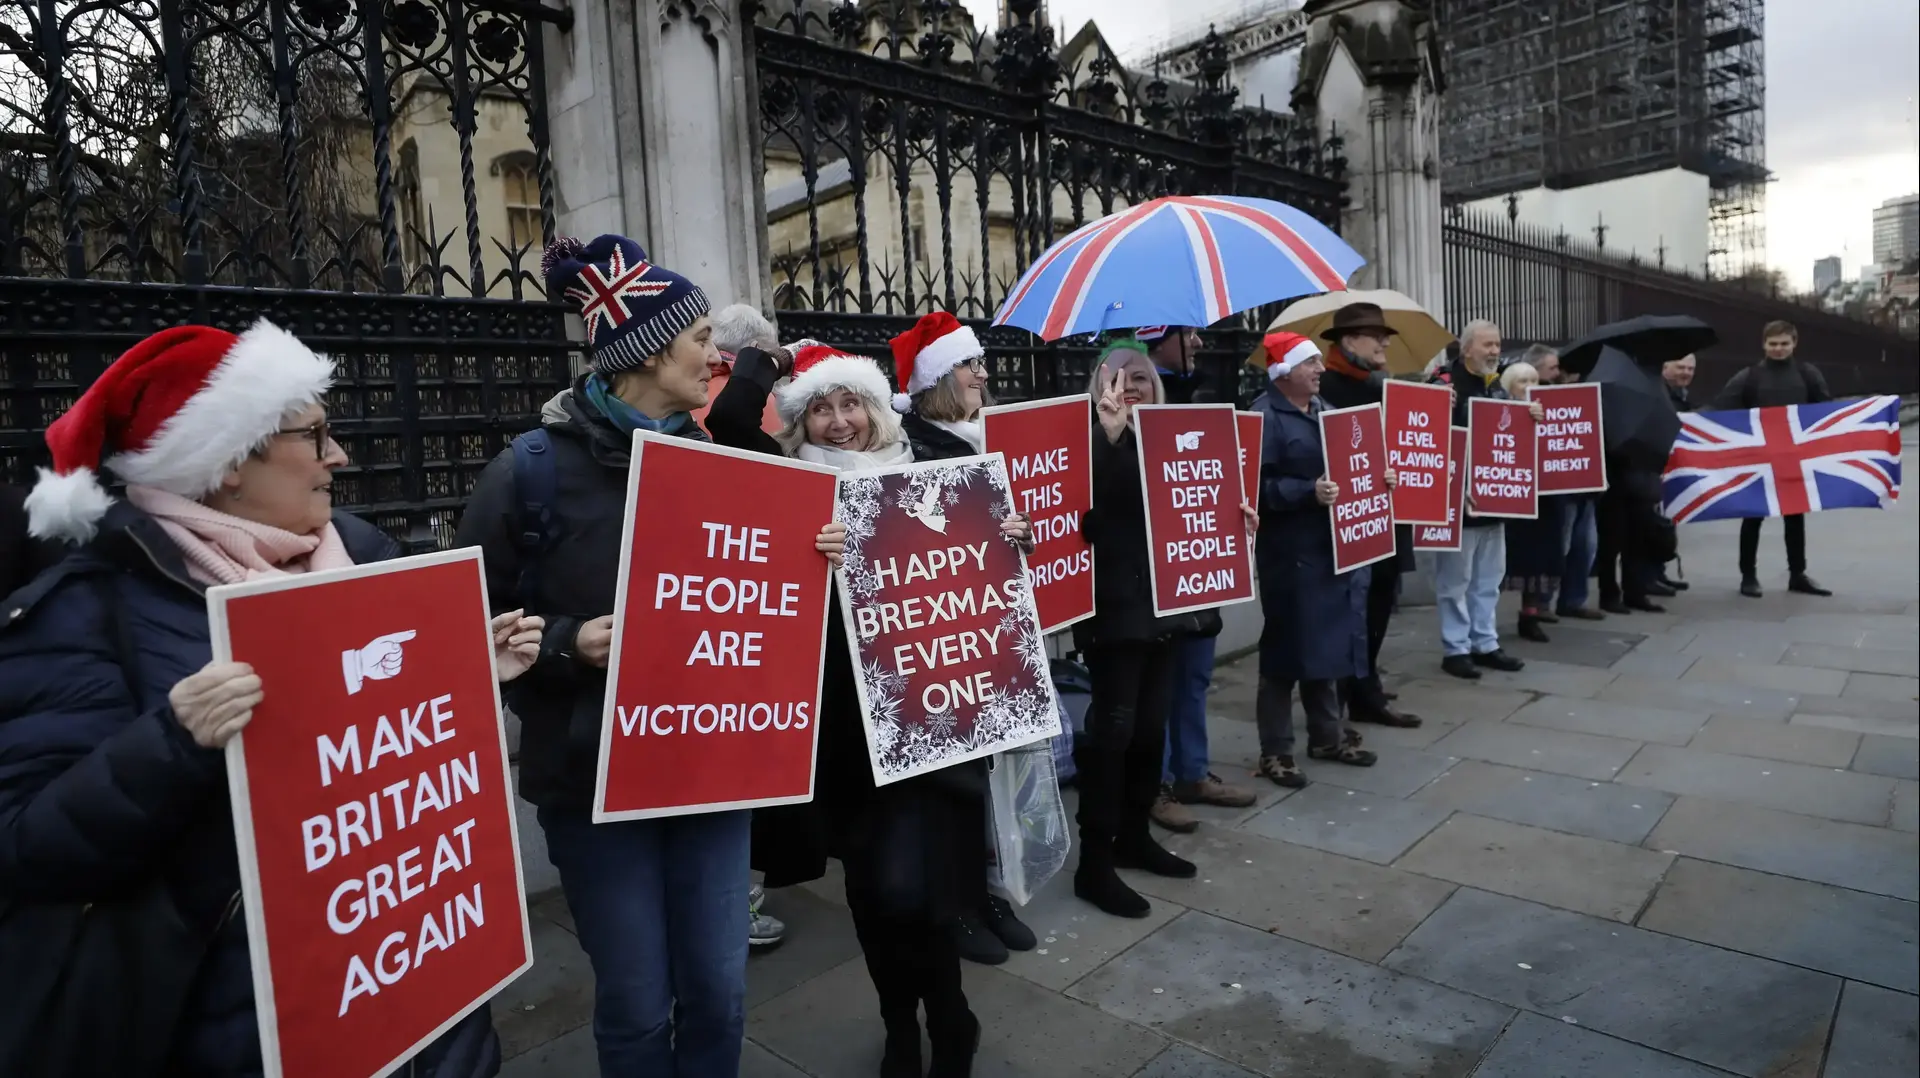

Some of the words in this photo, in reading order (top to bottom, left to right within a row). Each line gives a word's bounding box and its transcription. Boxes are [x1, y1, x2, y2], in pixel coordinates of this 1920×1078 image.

[1408, 411, 1428, 427] NO
[1545, 406, 1581, 420] NOW
[1398, 430, 1436, 447] LEVEL
[1493, 433, 1514, 447] IT'S
[1536, 421, 1591, 436] DELIVER
[1547, 437, 1583, 450] REAL
[1011, 447, 1069, 482] MAKE
[1349, 452, 1369, 471] IT'S
[1389, 450, 1443, 468] PLAYING
[1492, 450, 1515, 463] THE
[1543, 457, 1590, 472] BREXIT
[1163, 459, 1224, 482] NEVER
[1398, 471, 1433, 487] FIELD
[1474, 465, 1531, 481] PEOPLE'S
[1171, 485, 1221, 508] DEFY
[1350, 474, 1372, 494] THE
[1475, 483, 1530, 498] VICTORY
[1021, 482, 1063, 512] THIS
[1336, 493, 1388, 521] PEOPLE'S
[1182, 511, 1217, 534] THE
[1339, 515, 1389, 544] VICTORY
[1422, 527, 1451, 540] AGAIN
[702, 521, 771, 563] THE
[1166, 535, 1237, 563] PEOPLE
[873, 541, 989, 589] HAPPY
[654, 573, 800, 616] PEOPLE
[1175, 568, 1235, 597] AGAIN
[857, 579, 1023, 638] BREXMAS
[686, 630, 763, 666] ARE
[893, 625, 1002, 676] EVERY
[922, 671, 995, 714] ONE
[617, 701, 809, 736] VICTORIOUS
[316, 693, 456, 787] MAKE
[302, 751, 480, 872] BRITAIN
[327, 818, 476, 935] GREAT
[338, 883, 485, 1017] AGAIN
